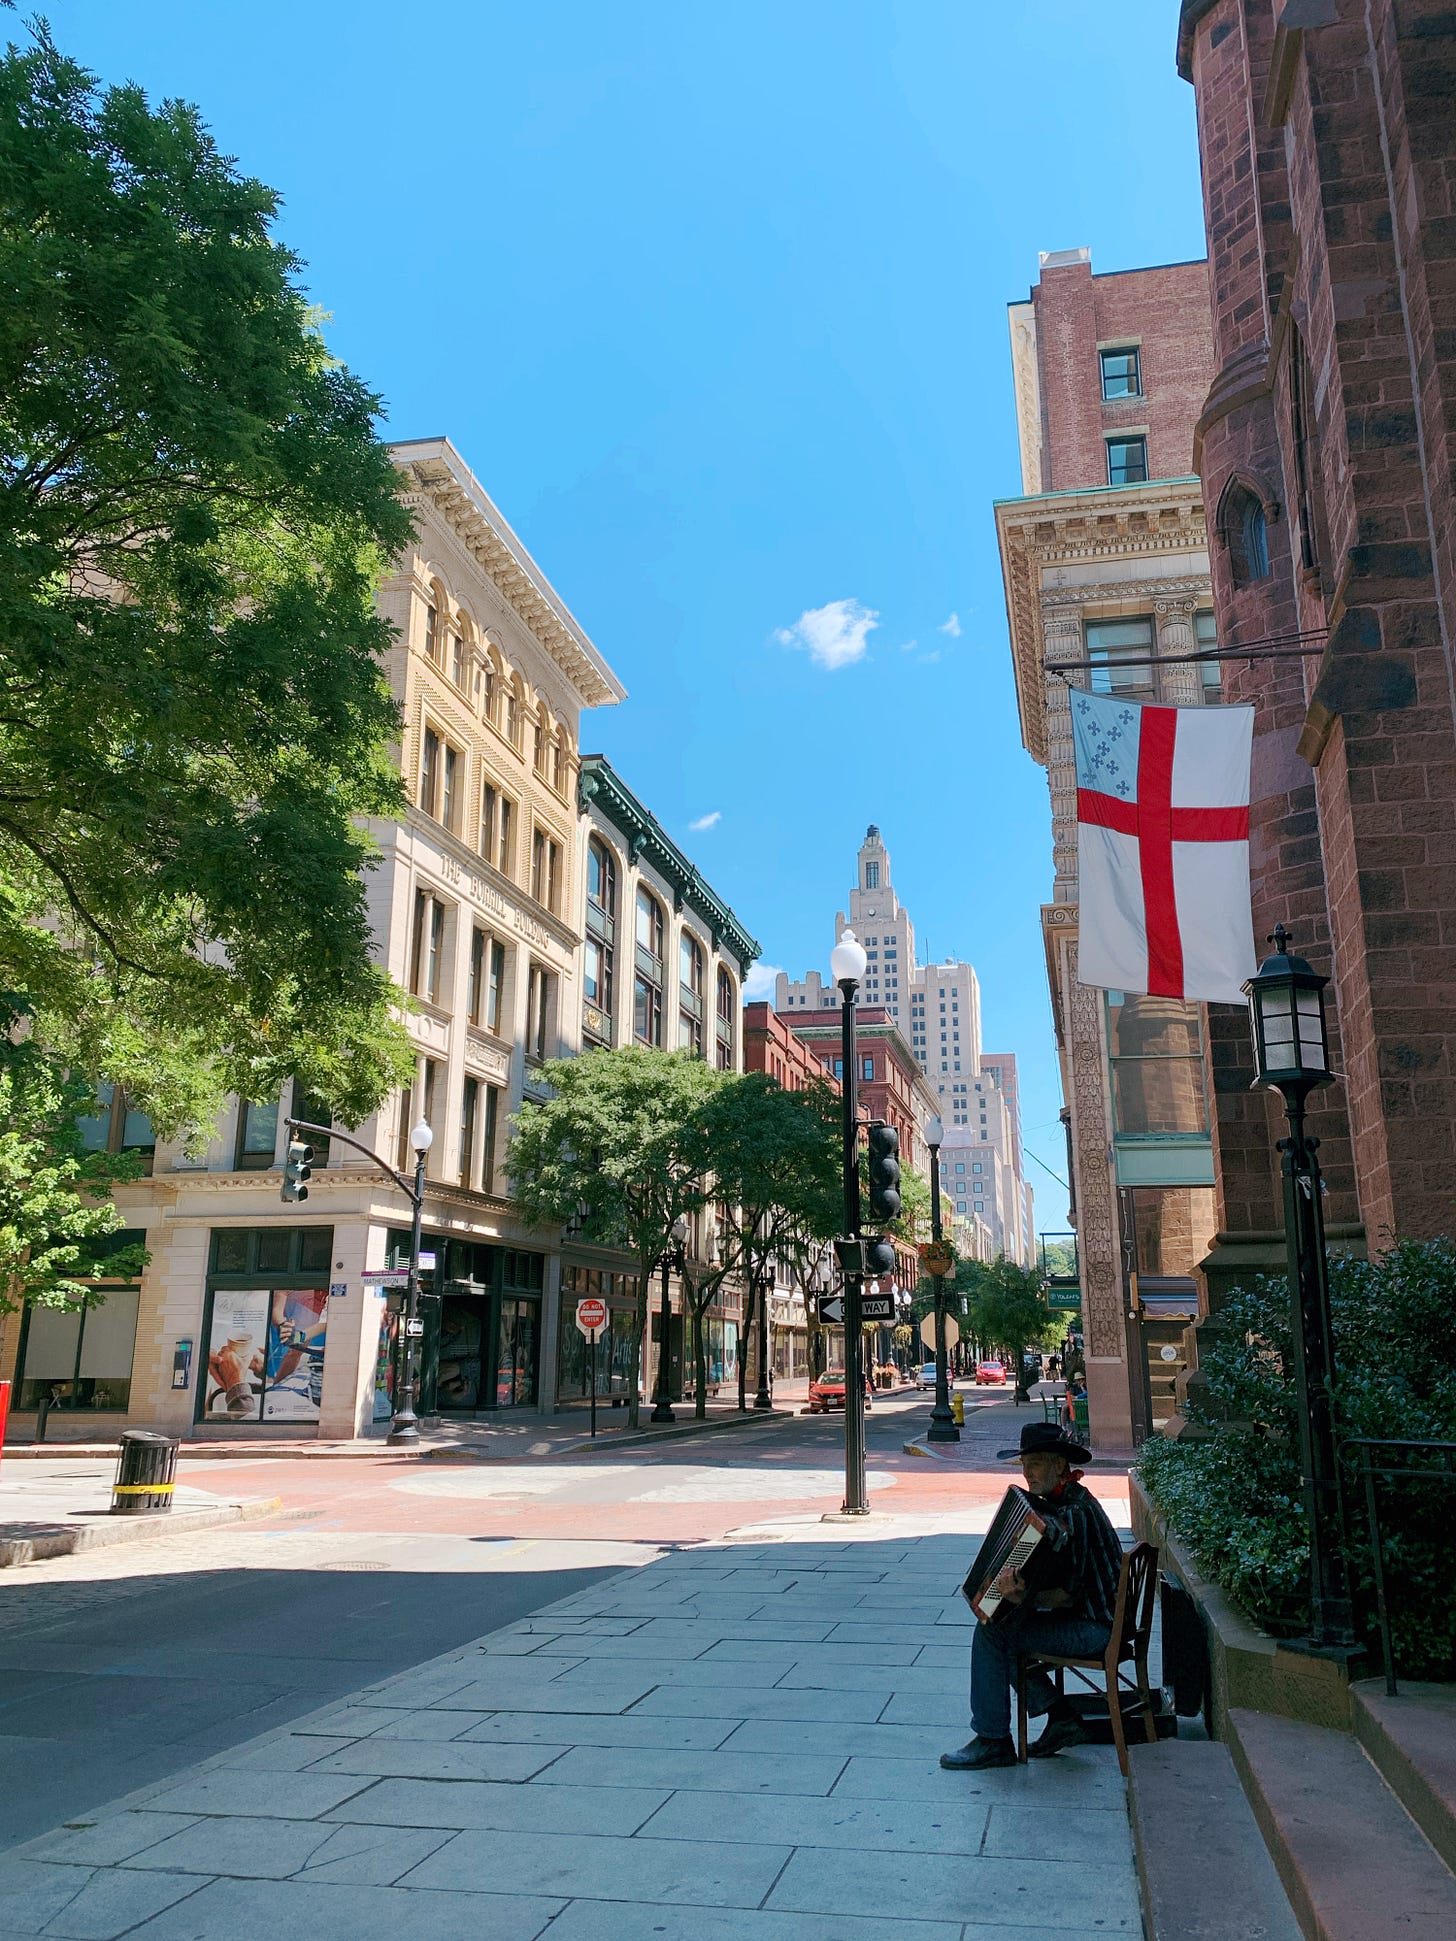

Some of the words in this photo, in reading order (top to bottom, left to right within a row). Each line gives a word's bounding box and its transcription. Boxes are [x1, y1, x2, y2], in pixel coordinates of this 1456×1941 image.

[441, 853, 462, 885] THE
[470, 876, 507, 919] BURRILL
[513, 909, 551, 949] BUILDING
[363, 1277, 399, 1285] MATHEWSON
[864, 1302, 886, 1313] WAY
